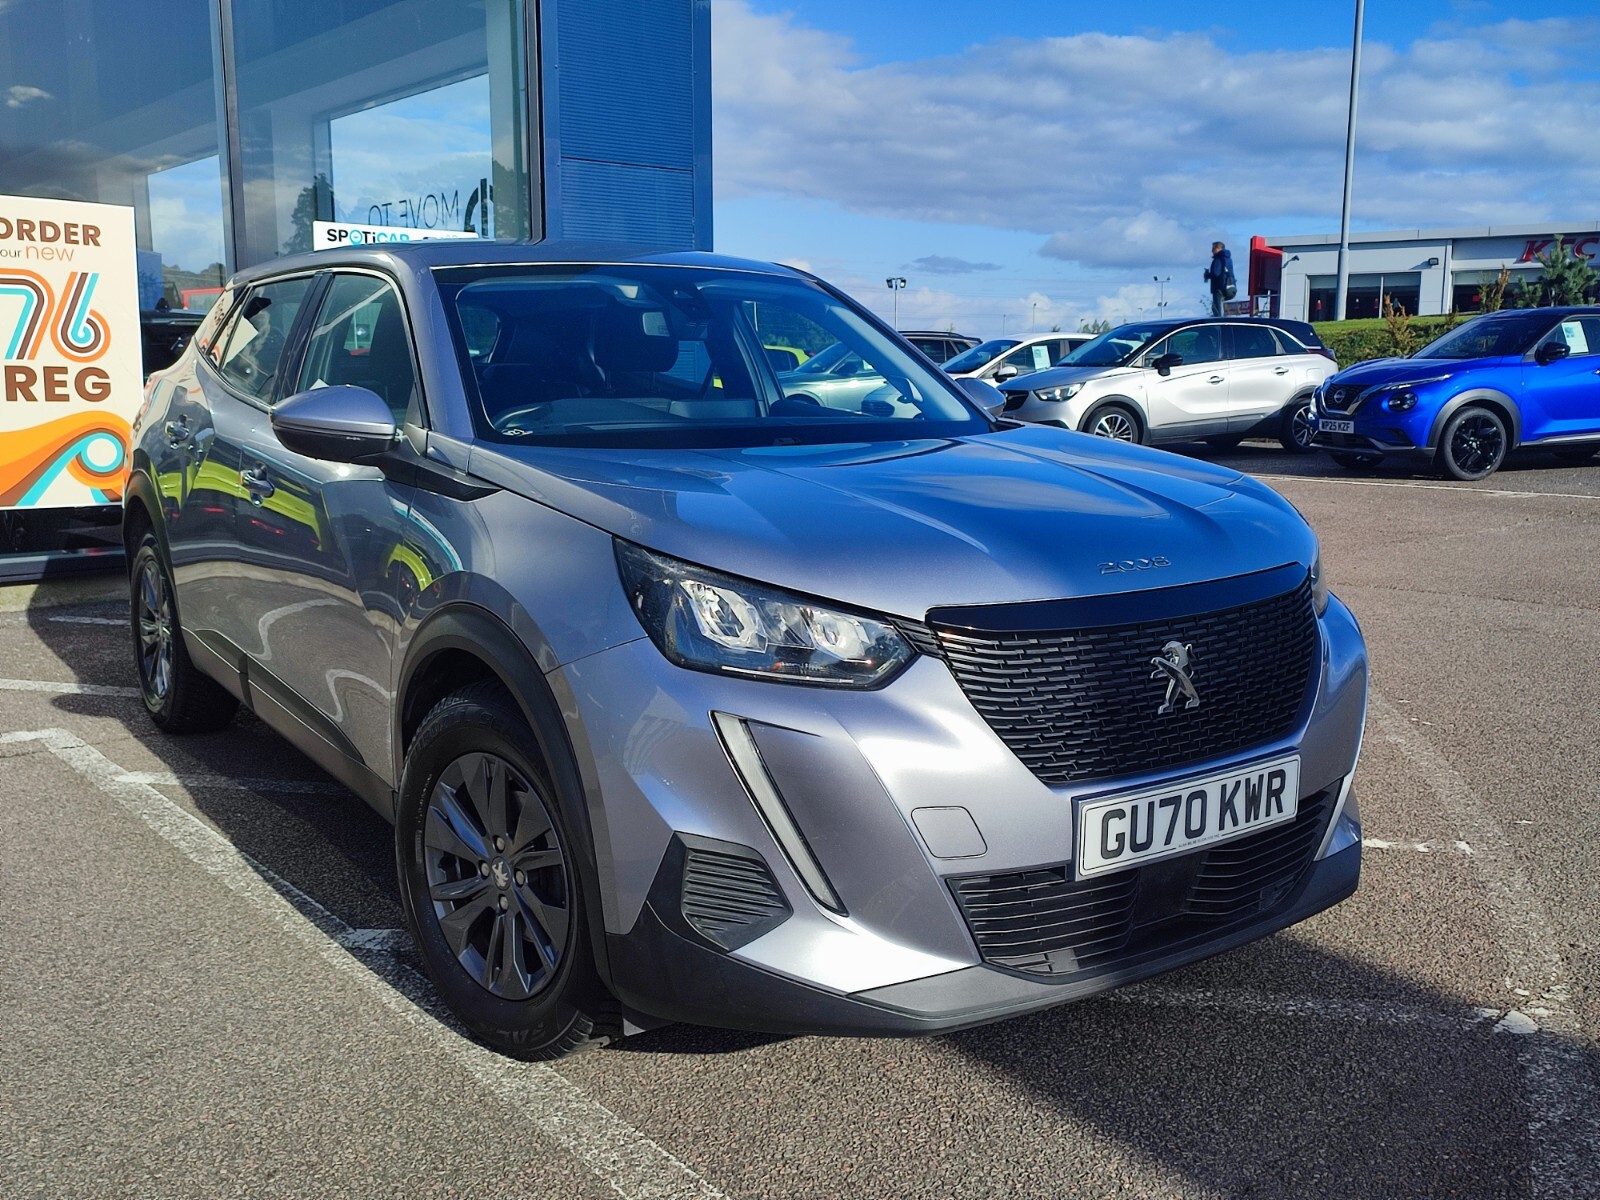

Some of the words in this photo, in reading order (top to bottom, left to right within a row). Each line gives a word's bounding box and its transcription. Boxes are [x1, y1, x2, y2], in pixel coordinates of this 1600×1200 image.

[0, 218, 102, 247] ORDER
[25, 245, 75, 261] new
[0, 267, 112, 363] 76
[4, 365, 112, 403] REG
[1097, 556, 1172, 574] 2008
[1101, 790, 1209, 860] GU70
[1218, 768, 1287, 831] KWR
